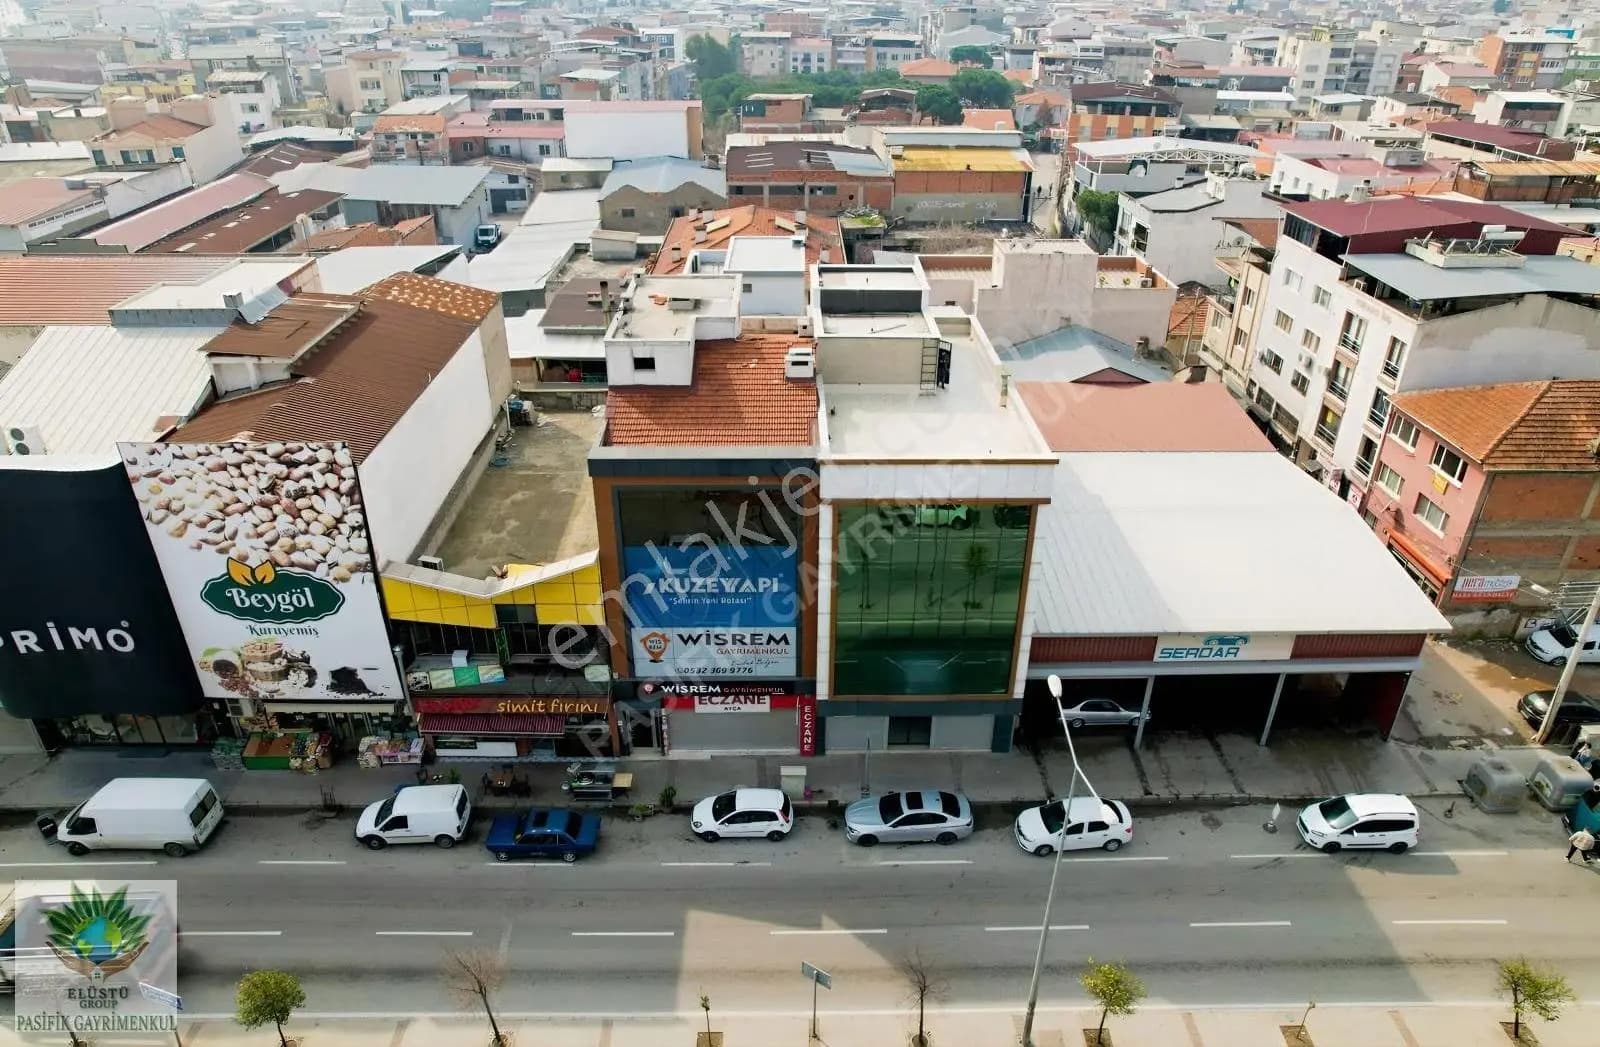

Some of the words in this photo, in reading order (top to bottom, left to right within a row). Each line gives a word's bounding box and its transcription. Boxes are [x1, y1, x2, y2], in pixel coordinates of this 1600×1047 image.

[225, 587, 314, 612] Beygöl
[0, 620, 134, 654] RİMO
[246, 624, 319, 638] Kuruyemiş
[677, 630, 790, 646] WİSREM
[661, 684, 721, 693] WİSREM
[497, 700, 545, 712] simit
[698, 696, 767, 705] ECZANE
[803, 706, 812, 751] ECZANE
